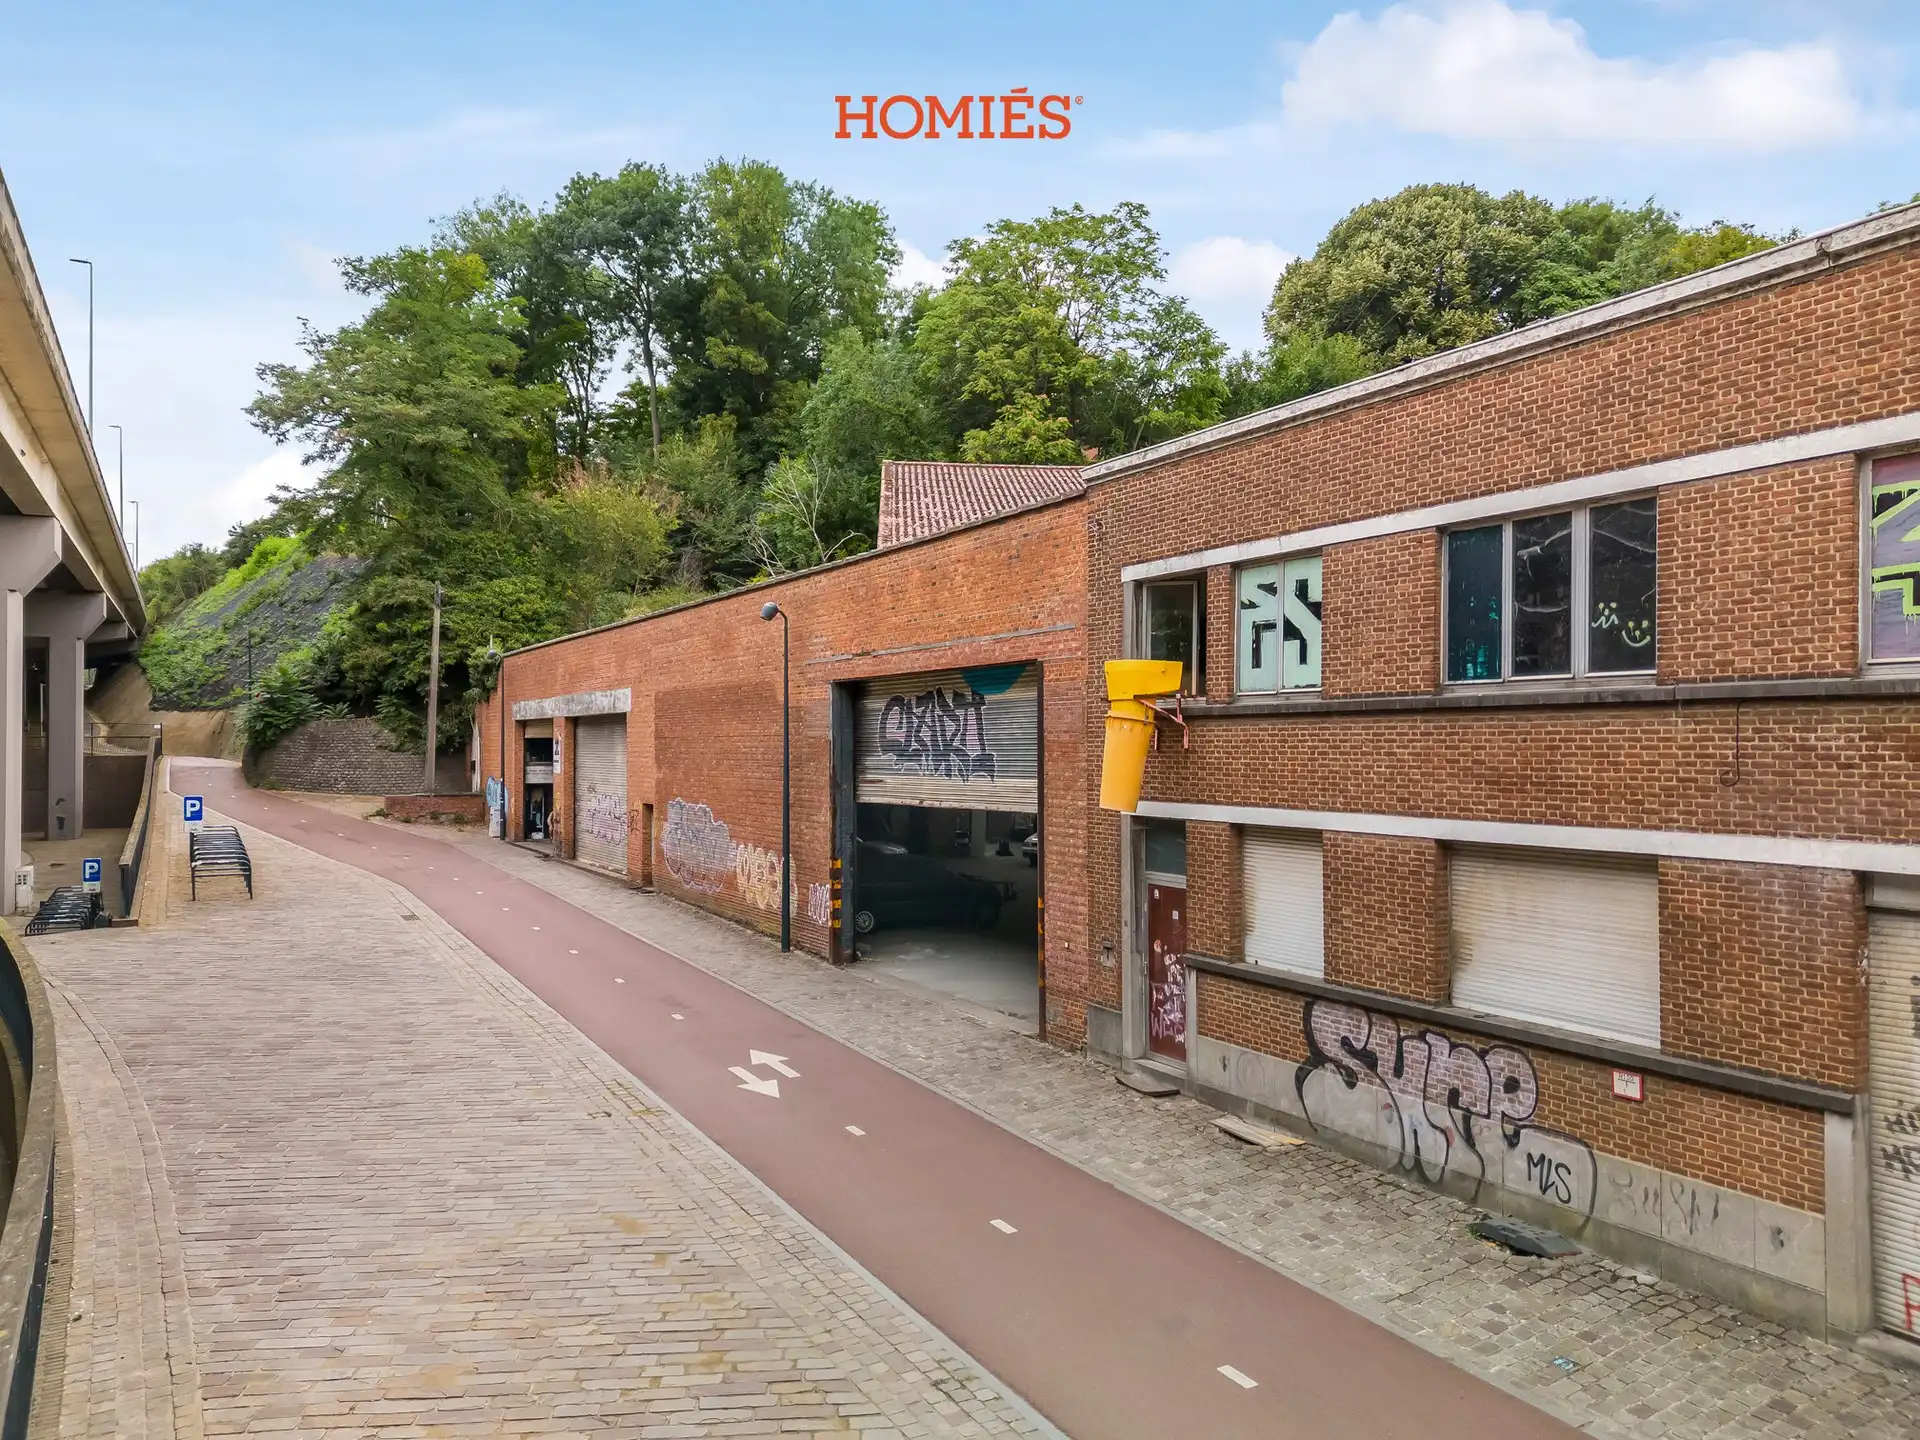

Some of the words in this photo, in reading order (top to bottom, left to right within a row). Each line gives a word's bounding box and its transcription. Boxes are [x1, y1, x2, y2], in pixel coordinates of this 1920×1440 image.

[186, 799, 200, 818] P
[85, 862, 99, 879] P
[1526, 1152, 1572, 1204] MLS
